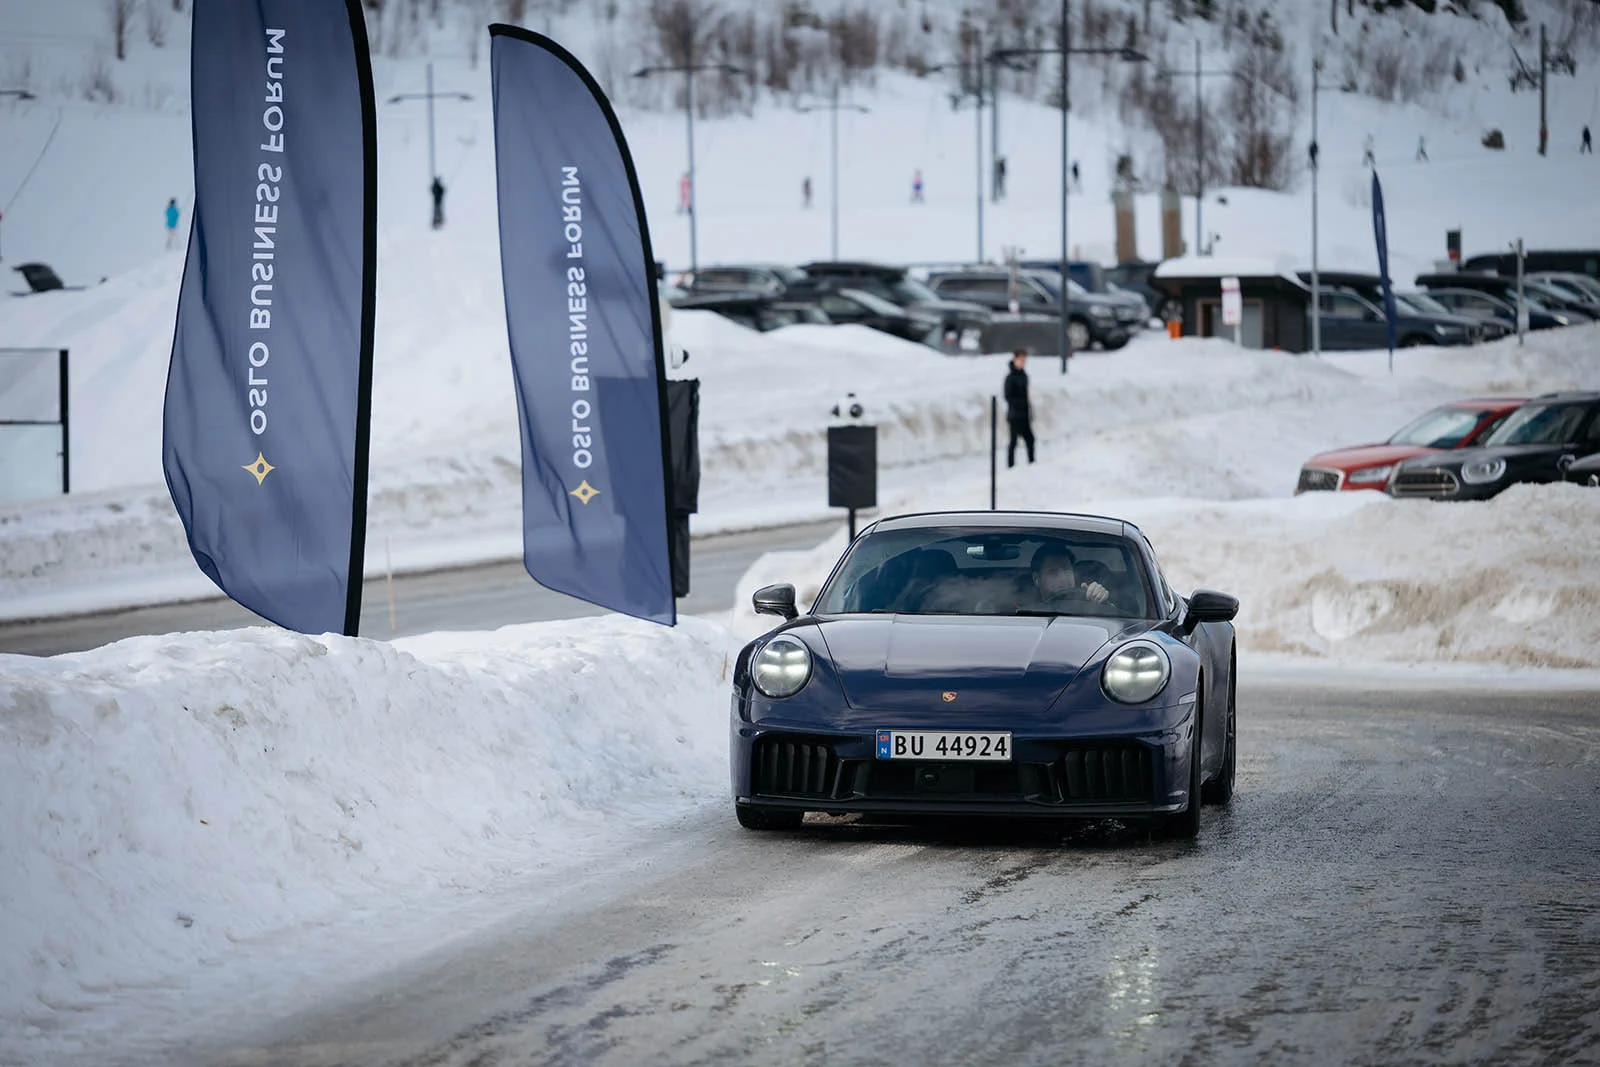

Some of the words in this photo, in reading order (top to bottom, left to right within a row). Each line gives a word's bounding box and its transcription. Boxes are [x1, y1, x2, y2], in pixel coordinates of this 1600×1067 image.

[880, 747, 888, 755] N
[894, 735, 924, 756] BU
[935, 735, 1008, 757] 44924
